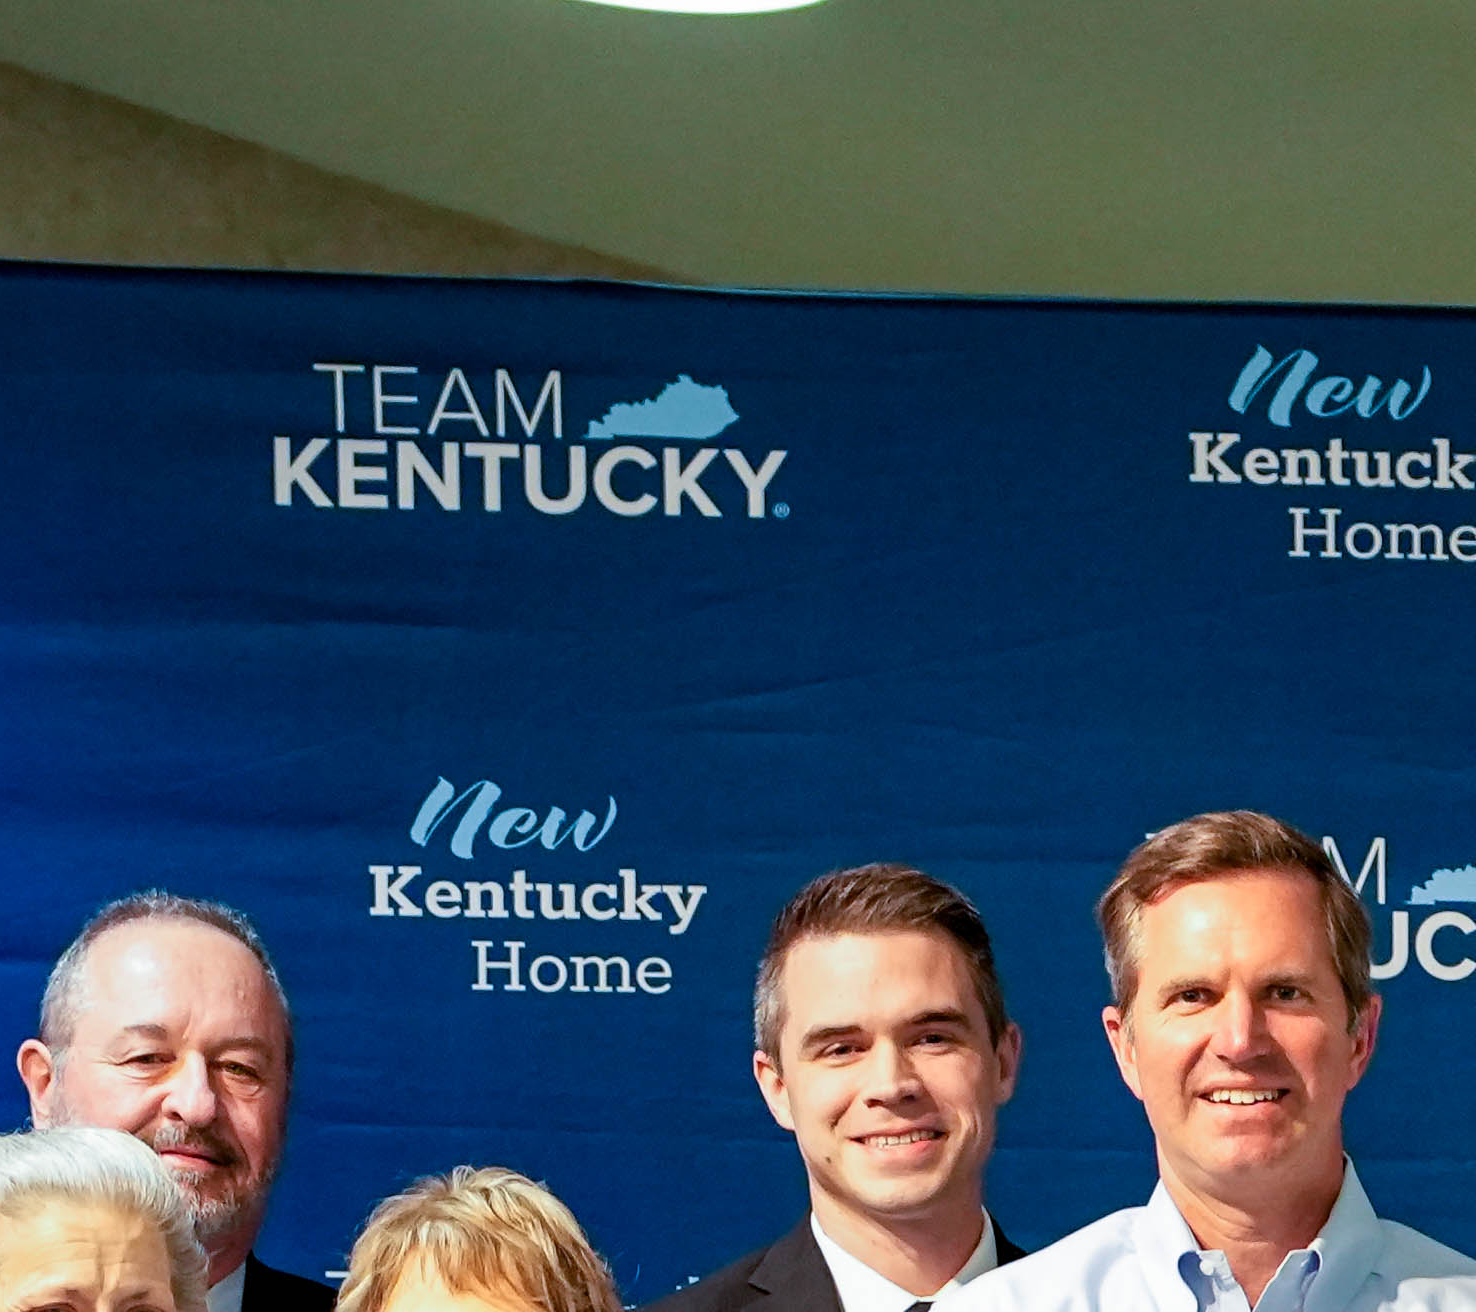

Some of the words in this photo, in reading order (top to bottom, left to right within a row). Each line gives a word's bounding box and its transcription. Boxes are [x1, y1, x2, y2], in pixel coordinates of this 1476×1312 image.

[313, 363, 563, 439] TEAM
[1228, 343, 1432, 428] New
[273, 435, 788, 518] KENTUCKY
[410, 776, 618, 859] New
[368, 865, 707, 935] Kentucky
[471, 940, 672, 994] Home
